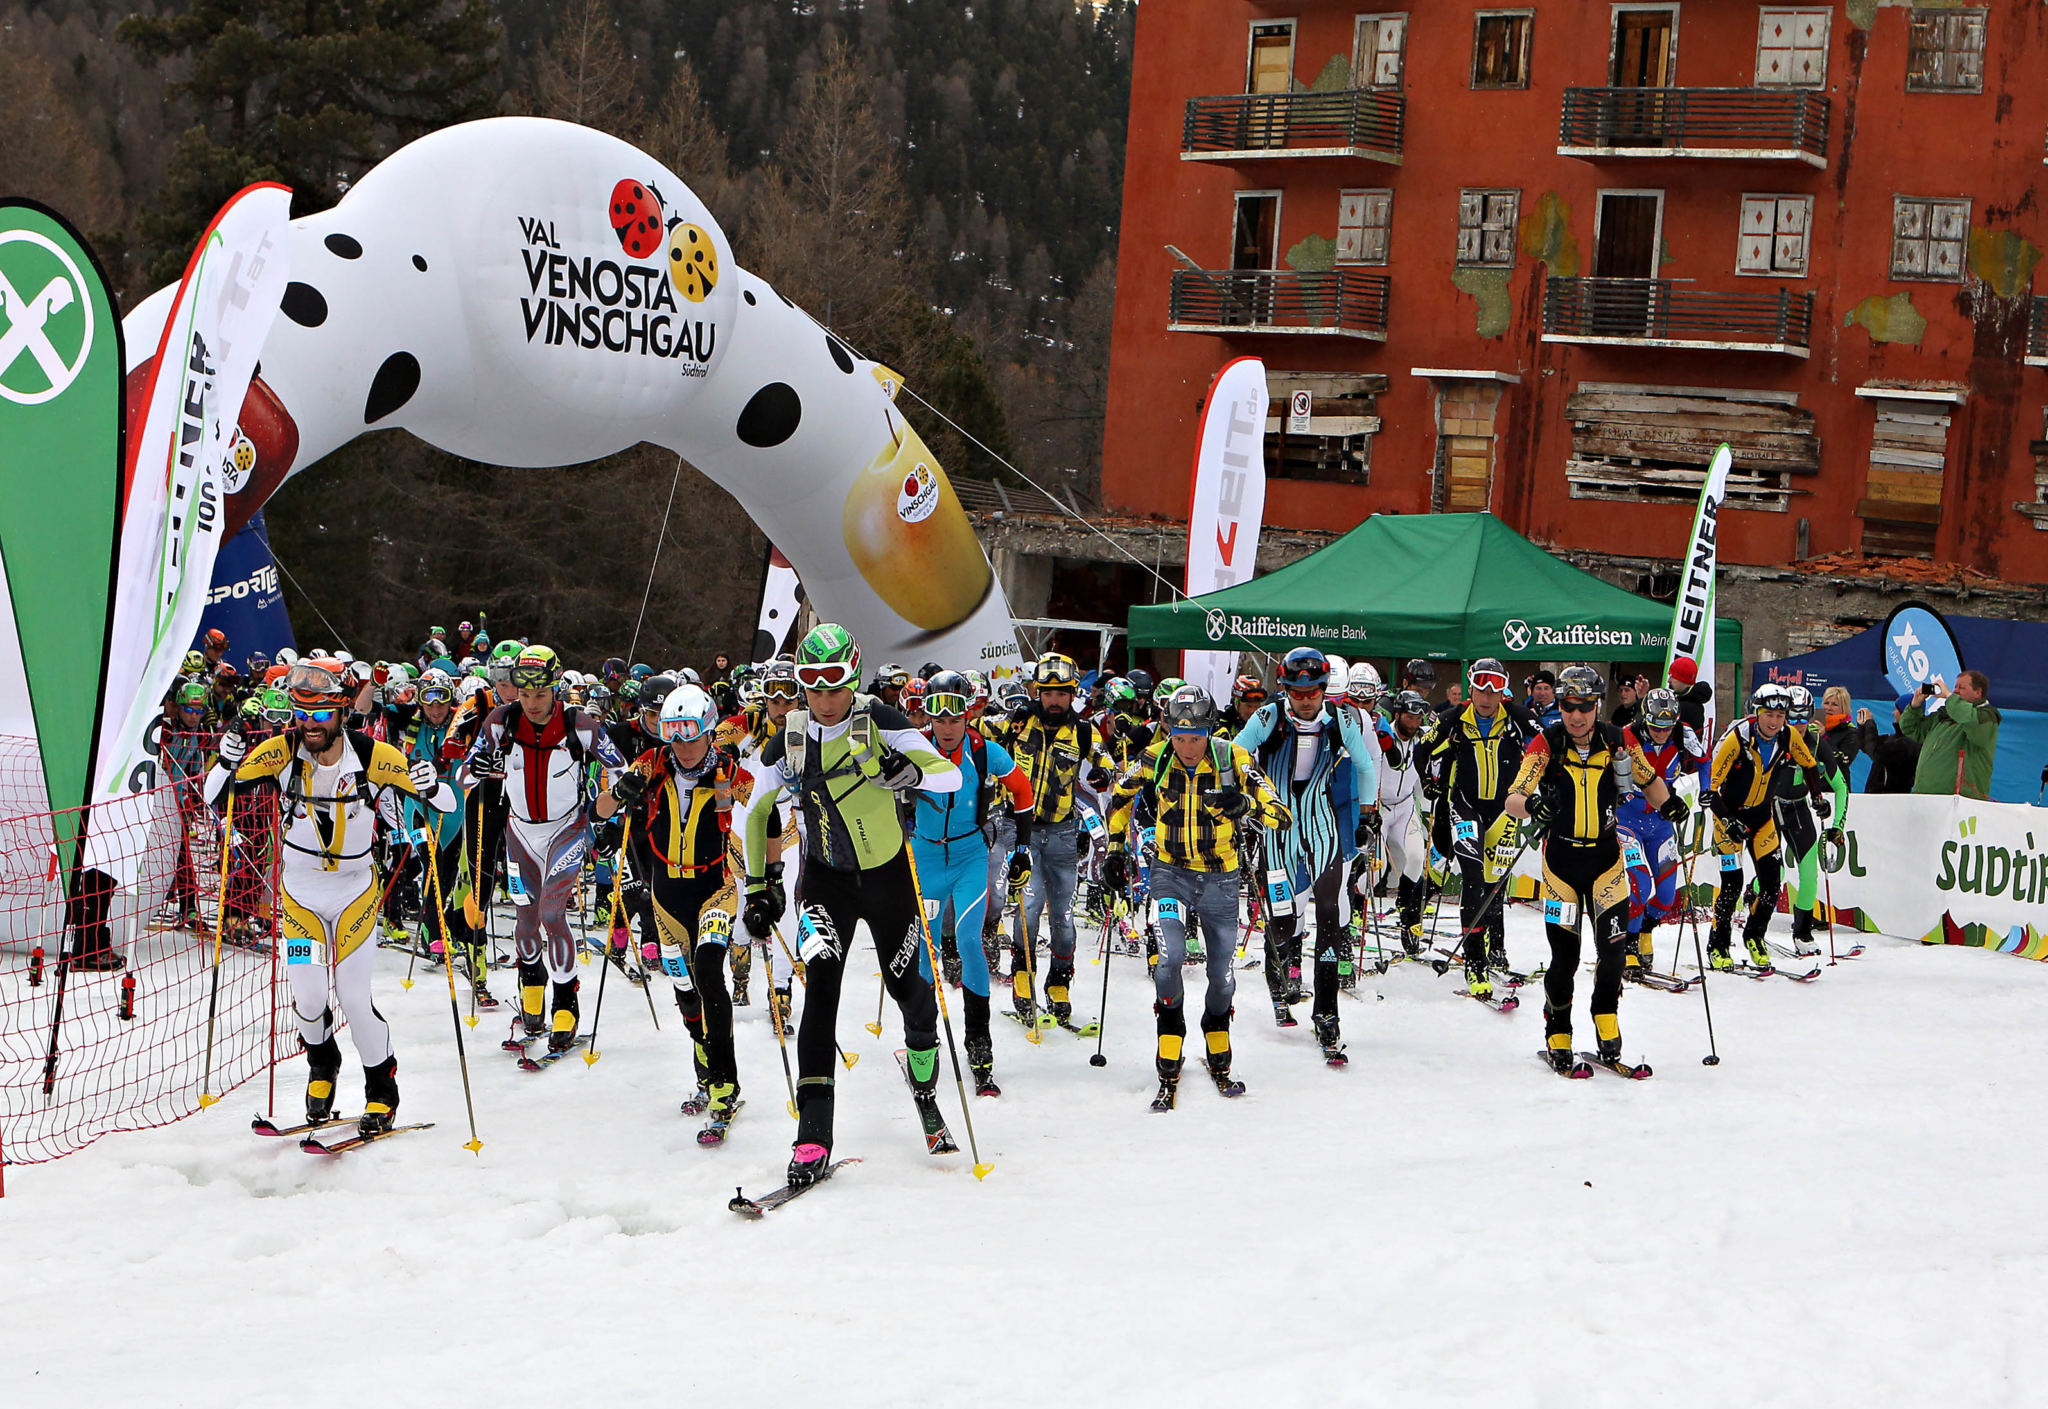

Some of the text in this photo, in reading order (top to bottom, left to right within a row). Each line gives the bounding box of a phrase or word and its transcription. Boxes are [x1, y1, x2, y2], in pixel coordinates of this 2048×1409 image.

[518, 216, 560, 249] VAL
[521, 249, 678, 314] VENOSTA
[520, 297, 716, 363] VINSCHGAU
[681, 363, 709, 378] Südtirol
[900, 477, 937, 518] VINSCHGAU
[1676, 494, 1718, 655] LEITNER
[1230, 615, 1367, 640] Raiffeisen Meine Bank
[1535, 624, 1633, 646] Raiffeisen
[1456, 825, 1474, 836] 218
[1626, 852, 1642, 863] 042
[1721, 857, 1738, 867] 041
[1274, 883, 1286, 903] 003
[1158, 902, 1179, 914] 026
[287, 945, 312, 957] 099
[888, 922, 917, 972] RIFUGIO
[667, 959, 682, 978] 032
